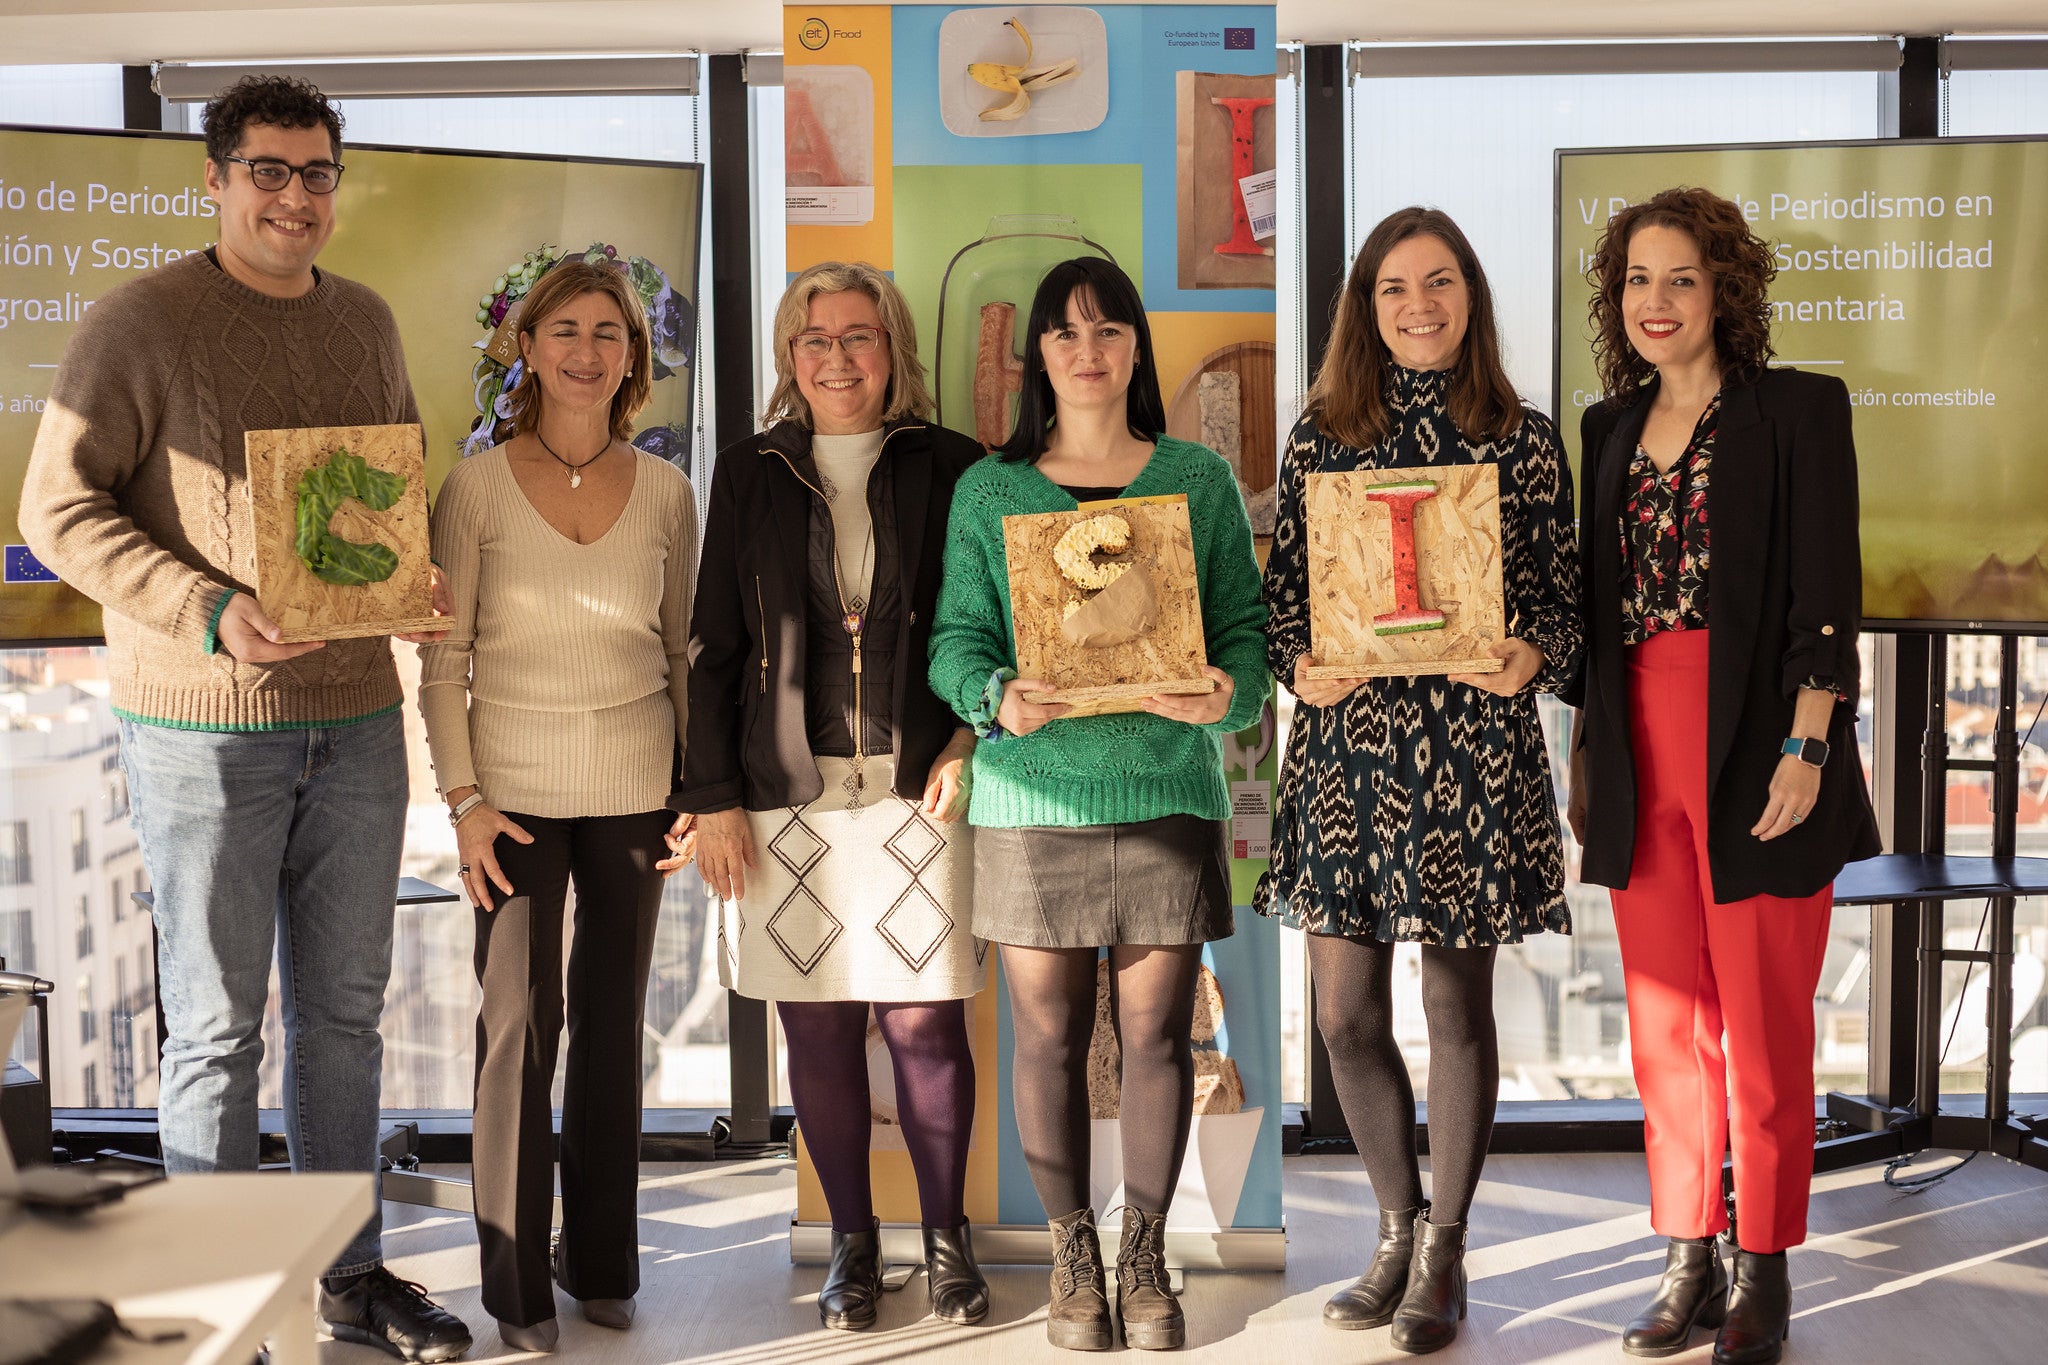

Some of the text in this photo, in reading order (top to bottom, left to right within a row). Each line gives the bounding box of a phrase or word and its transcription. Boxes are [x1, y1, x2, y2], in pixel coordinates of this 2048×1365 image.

[806, 28, 862, 39] eit Food
[1200, 31, 1208, 39] by
[37, 181, 76, 212] de
[87, 183, 217, 219] Periodis
[1579, 198, 1599, 225] V
[1770, 191, 1946, 221] Periodismo
[1955, 195, 1993, 217] en
[0, 235, 52, 266] ión
[64, 245, 82, 275] y
[1775, 240, 1993, 272] Sostenibilidad
[1892, 388, 1996, 407] comestible
[1249, 845, 1266, 853] 1.000
